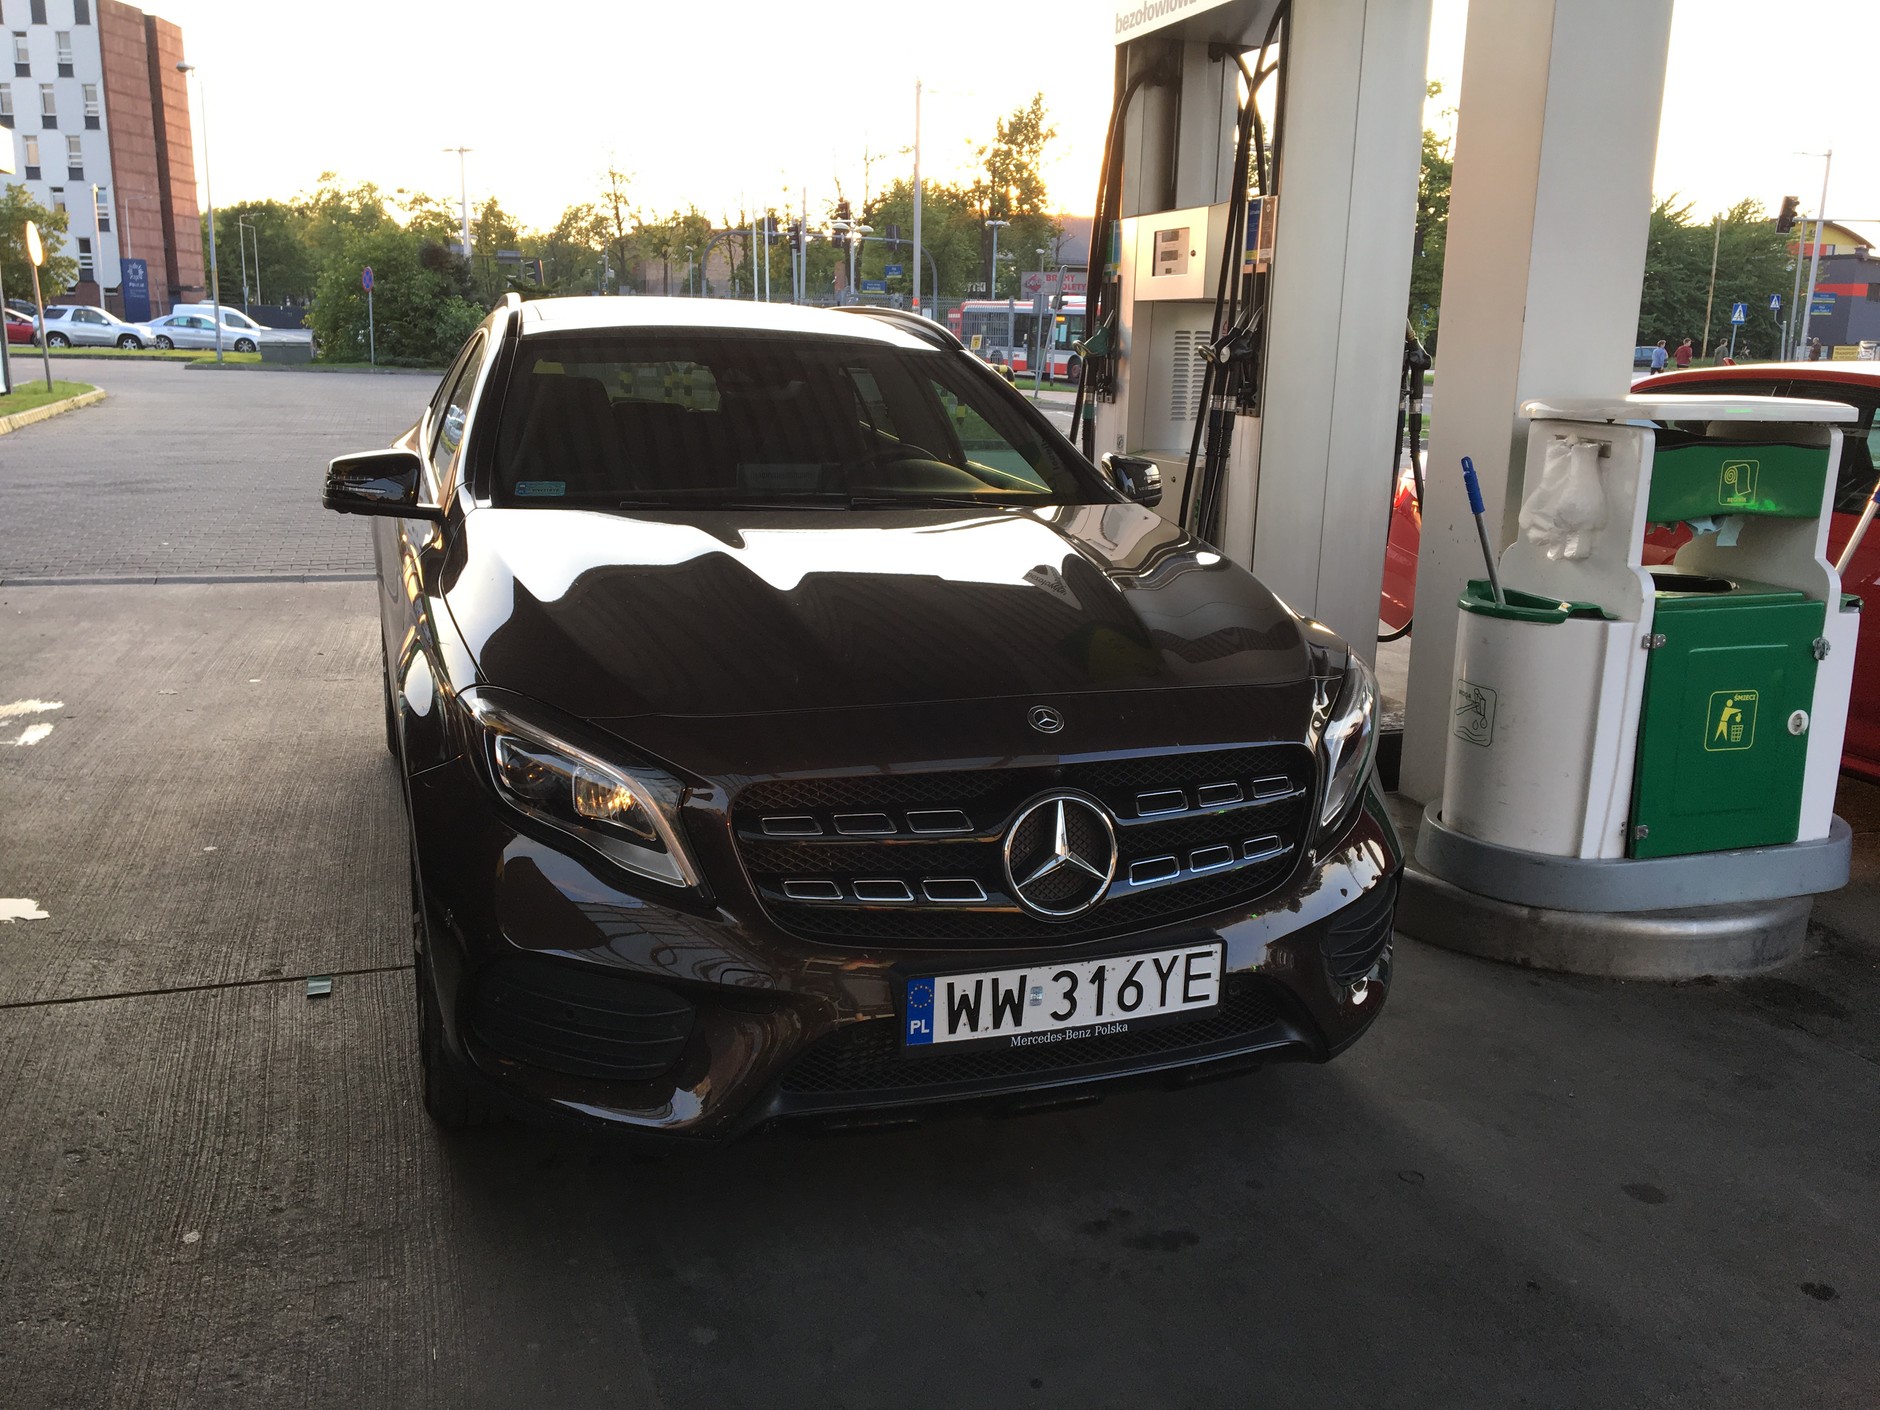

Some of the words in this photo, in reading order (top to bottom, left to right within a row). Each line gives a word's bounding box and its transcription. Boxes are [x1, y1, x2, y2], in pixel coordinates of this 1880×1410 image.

[946, 974, 1027, 1035] WW
[1050, 950, 1214, 1021] 316YE
[910, 1019, 930, 1035] PL
[1010, 1028, 1092, 1047] Mercedes-Benz
[1094, 1022, 1129, 1036] Polska
